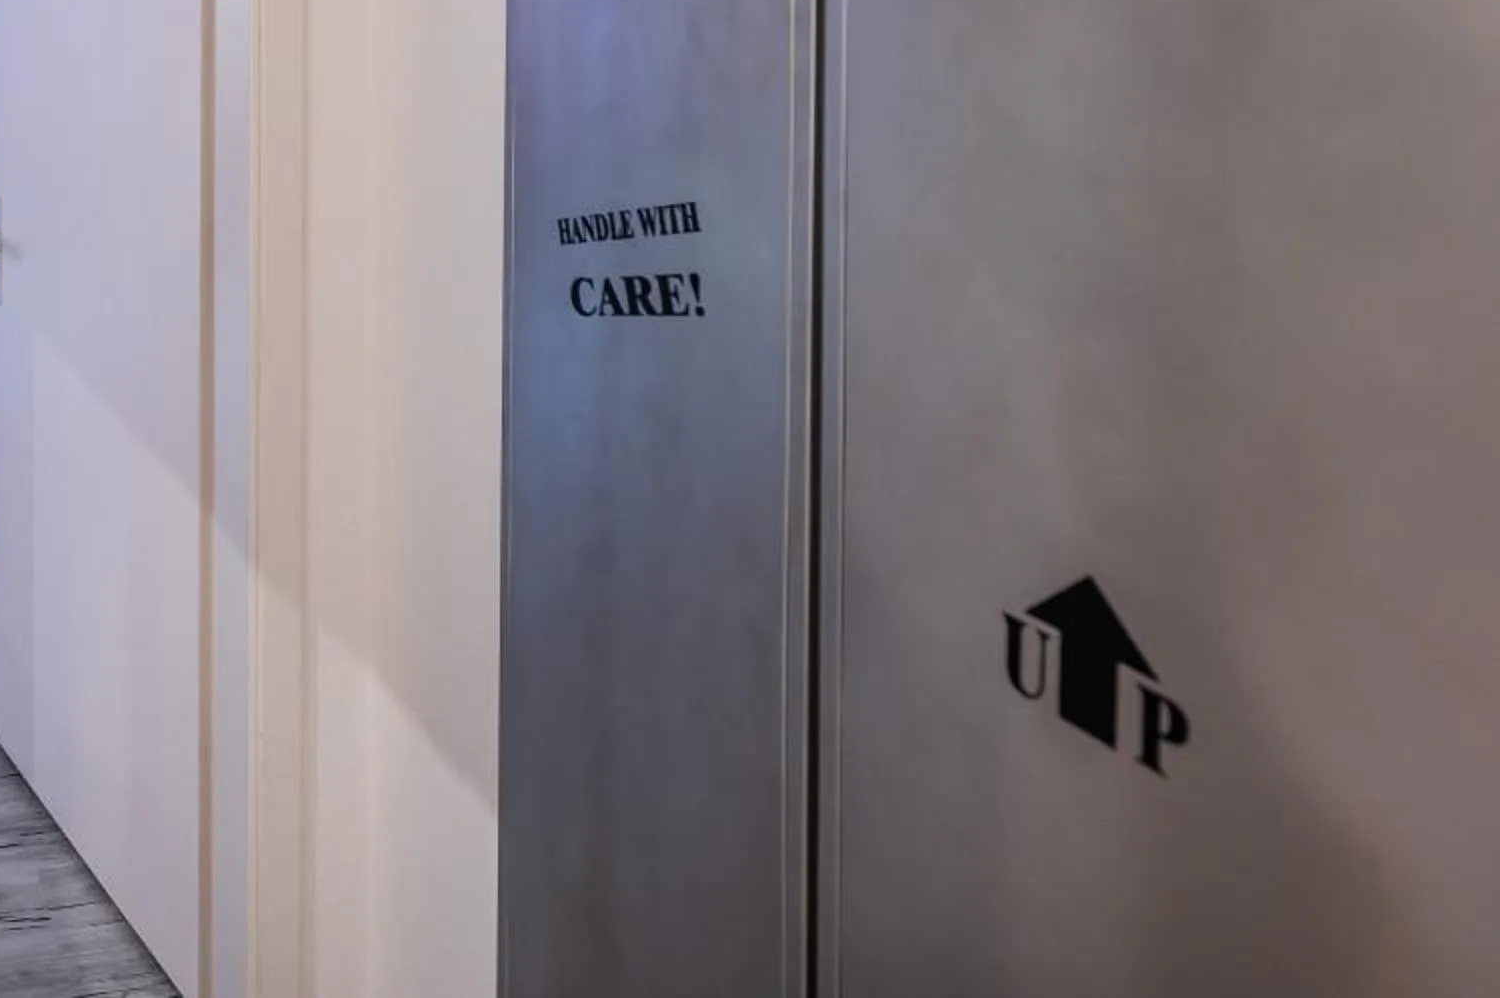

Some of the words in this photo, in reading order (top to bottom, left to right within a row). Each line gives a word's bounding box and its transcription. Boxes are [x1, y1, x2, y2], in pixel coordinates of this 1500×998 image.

[557, 213, 635, 246] HANDLE
[637, 202, 701, 238] WITH
[570, 272, 706, 317] CARE!
